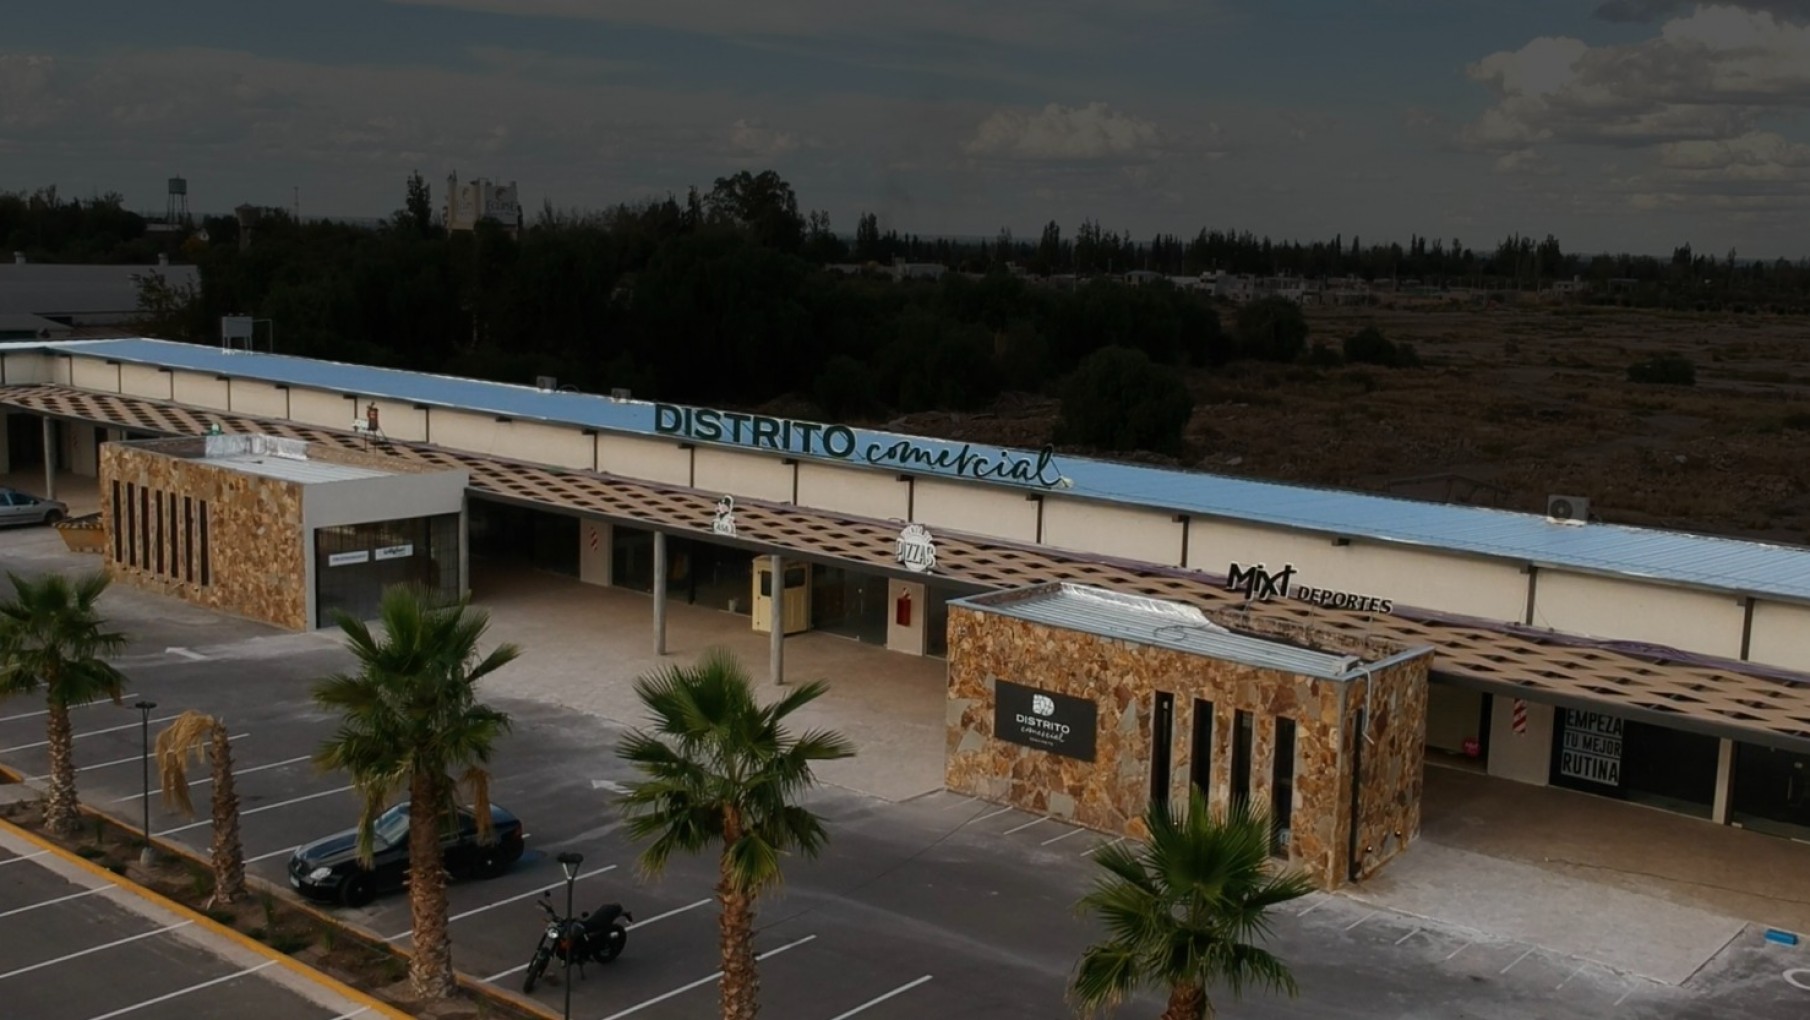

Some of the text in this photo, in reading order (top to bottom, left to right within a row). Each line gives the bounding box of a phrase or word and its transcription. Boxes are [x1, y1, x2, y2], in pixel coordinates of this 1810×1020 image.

[654, 403, 1062, 487] DISTRITO comercial
[1297, 586, 1393, 613] DEPORTES
[1015, 714, 1070, 734] DISTRITO
[1566, 708, 1622, 735] EMPEZA
[1565, 732, 1621, 756] TU MEJOR
[1563, 753, 1618, 782] RUTINA
